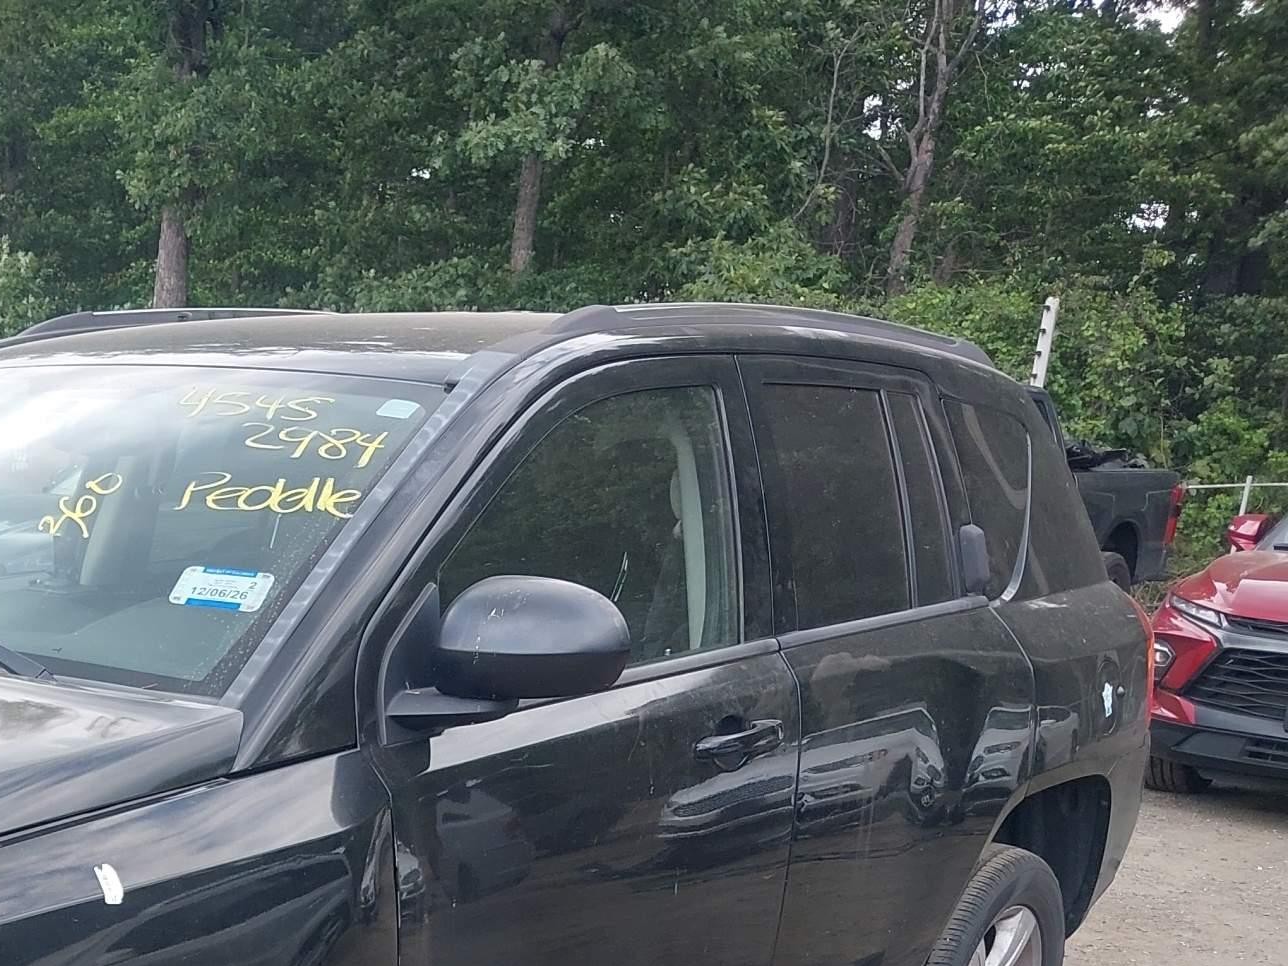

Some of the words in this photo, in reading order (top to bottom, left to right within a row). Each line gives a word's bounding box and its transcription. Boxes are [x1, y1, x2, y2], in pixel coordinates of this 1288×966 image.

[179, 386, 335, 420] 4545
[243, 422, 389, 468] 2984
[191, 586, 249, 600] 12/06/26
